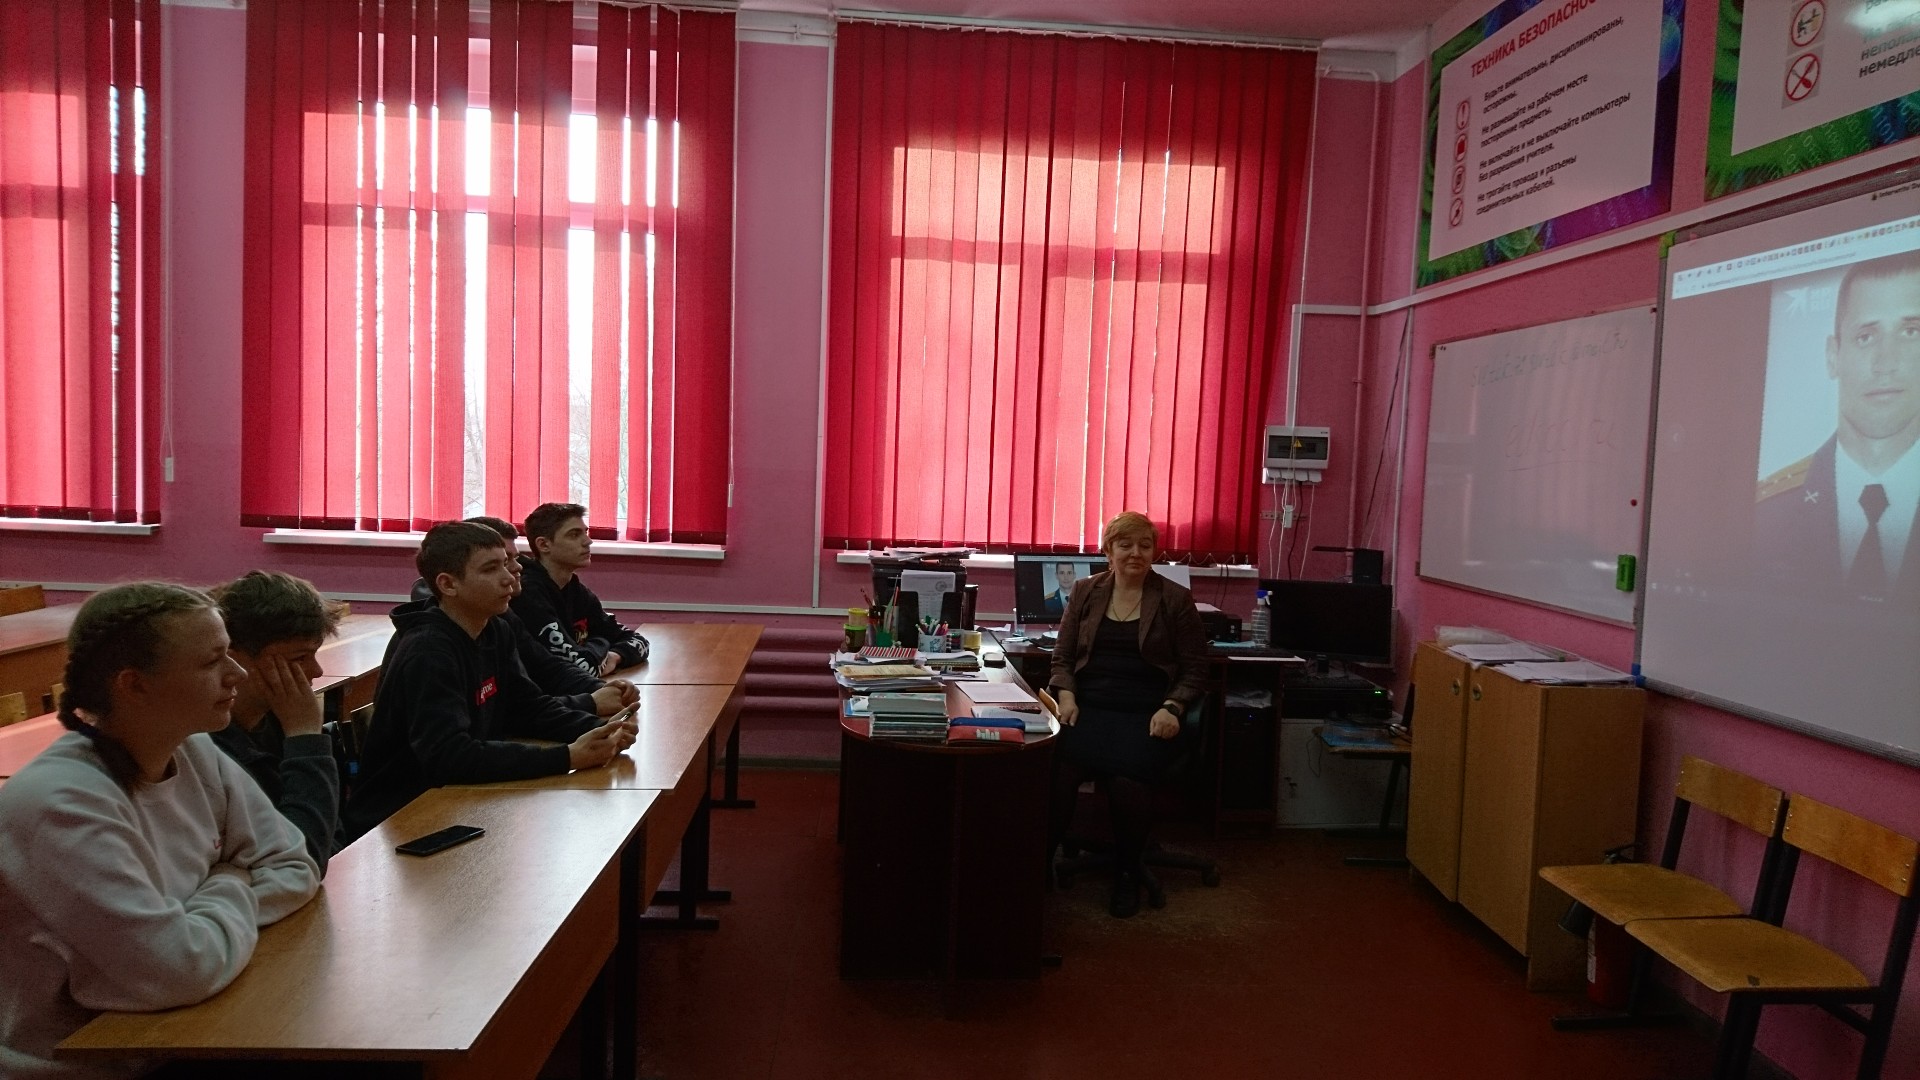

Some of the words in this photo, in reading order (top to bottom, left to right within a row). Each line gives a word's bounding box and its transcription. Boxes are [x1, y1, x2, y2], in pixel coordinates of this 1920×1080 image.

[1471, 39, 1516, 78] ТЕХНИКА
[1482, 126, 1490, 135] Не
[1528, 101, 1535, 111] на
[1536, 85, 1565, 109] рабочем
[1566, 74, 1588, 90] месте
[1484, 84, 1504, 102] Будьте
[1479, 160, 1487, 170] Не
[1488, 144, 1520, 166] включайте
[1526, 138, 1535, 147] не
[1536, 116, 1580, 143] выключайте
[1580, 92, 1631, 123] компьютеры
[1519, 106, 1552, 130] предметы.
[1477, 193, 1485, 203] Не
[1486, 182, 1511, 200] трогайте
[1512, 171, 1538, 189] провода
[1546, 154, 1577, 177] разъемы
[1489, 155, 1525, 180] разрешения
[1526, 142, 1555, 163] учителя.
[1526, 176, 1555, 195] кабелей.
